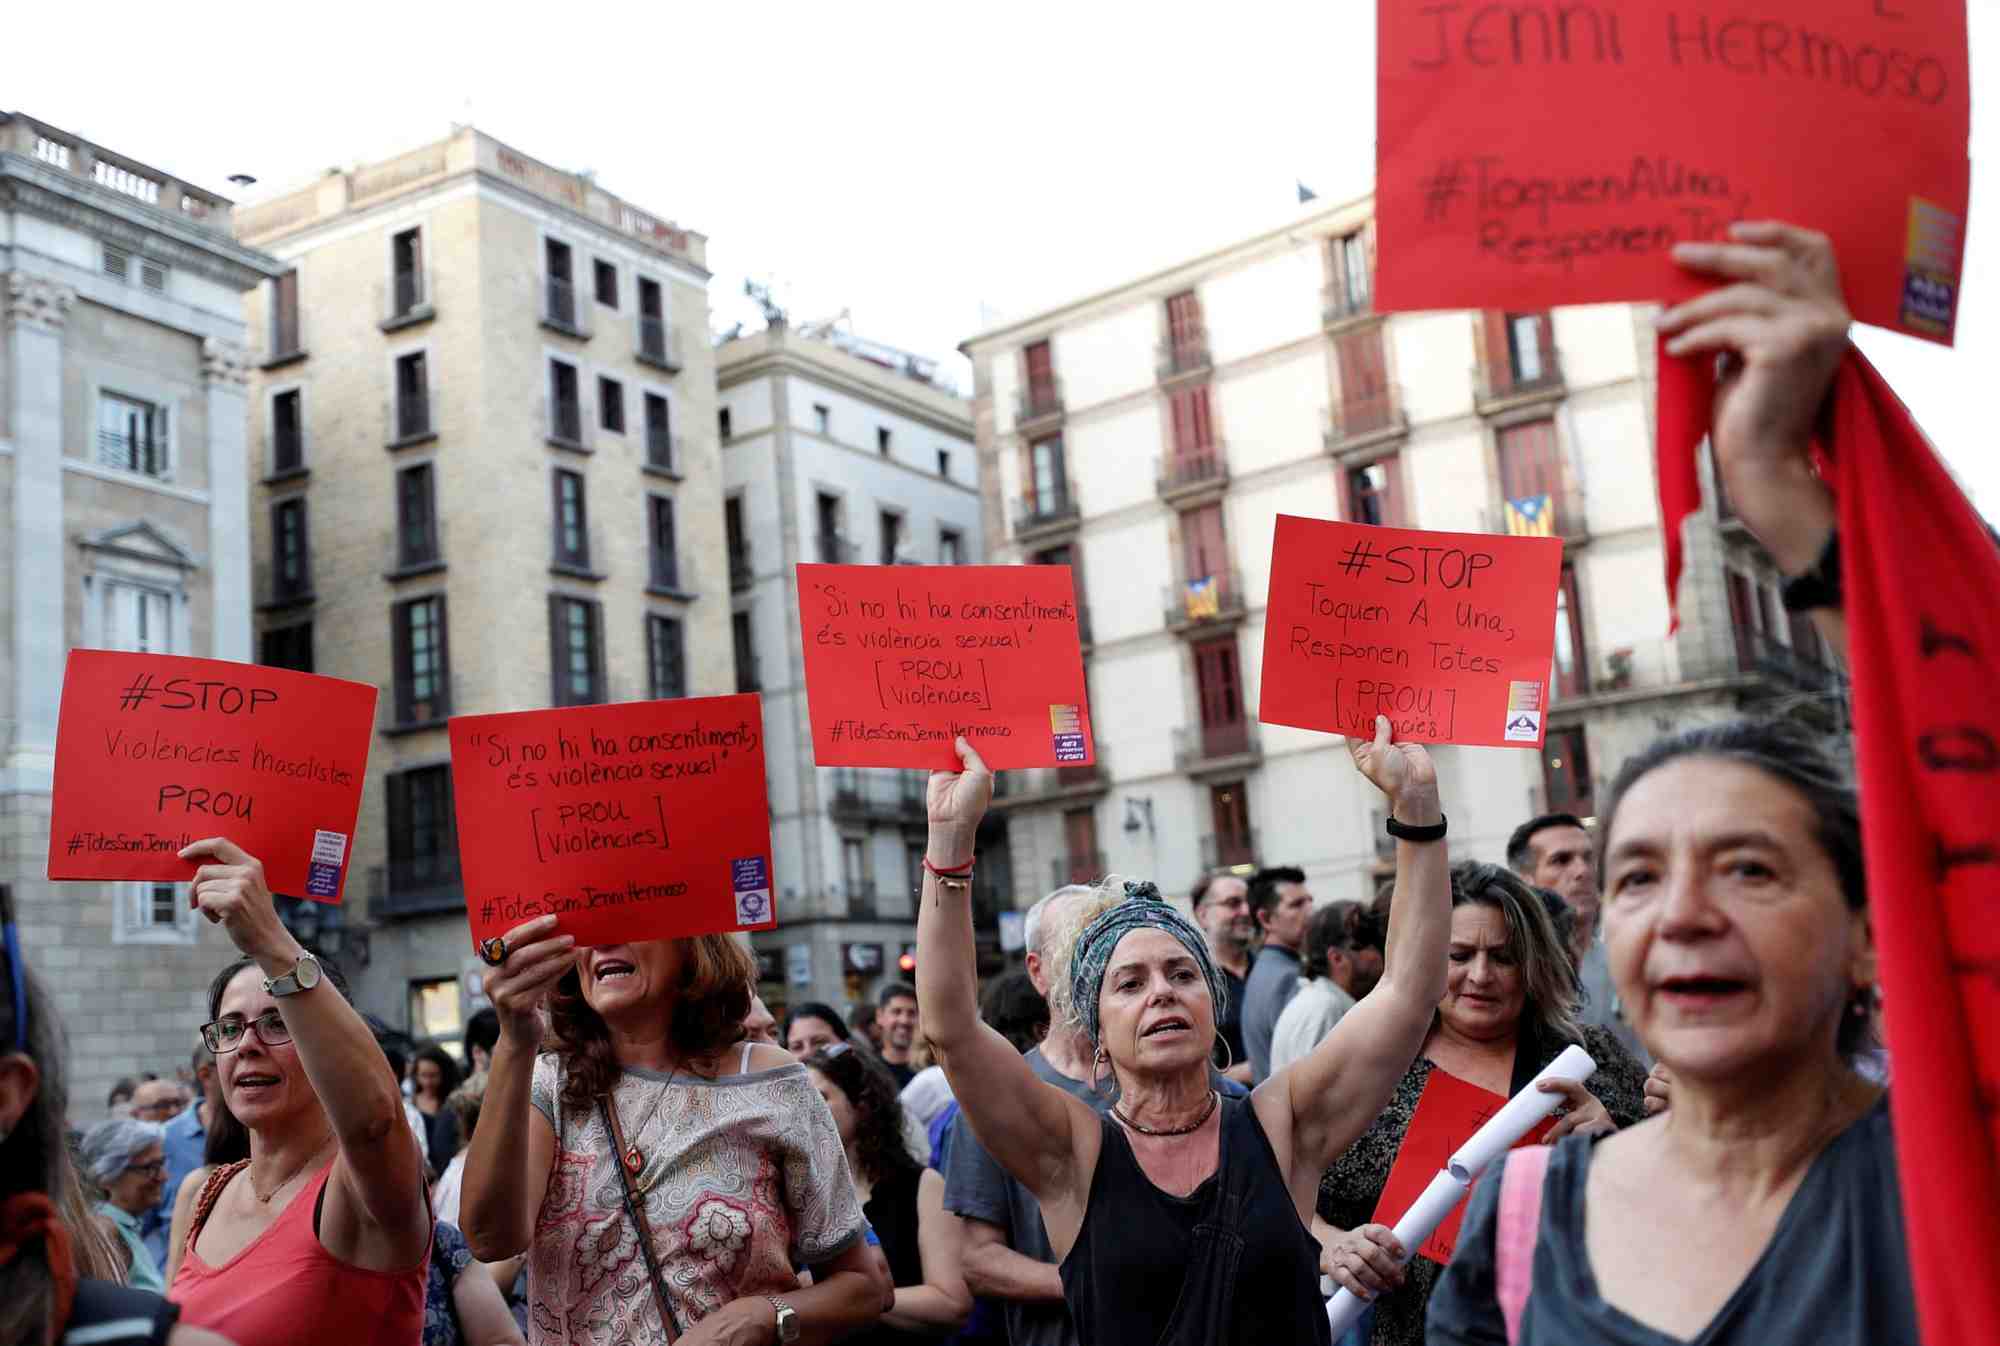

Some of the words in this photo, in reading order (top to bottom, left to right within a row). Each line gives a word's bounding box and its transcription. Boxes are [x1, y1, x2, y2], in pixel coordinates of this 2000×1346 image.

[1337, 540, 1493, 589] #STOP
[860, 599, 886, 619] no
[896, 587, 917, 620] hi
[927, 591, 952, 619] ha
[959, 594, 1075, 622] consentiment,
[1306, 582, 1391, 636] Toquen
[1408, 598, 1429, 627] A
[1455, 603, 1516, 641] Una,
[816, 623, 848, 646] és
[857, 626, 943, 649] violència
[1290, 625, 1409, 669] Responen
[1429, 642, 1502, 674] Totes
[900, 658, 963, 681] PROU
[120, 673, 279, 715] #STOP
[1356, 679, 1434, 717] PROU
[1347, 711, 1438, 738] Vioncies
[521, 743, 547, 761] no
[558, 728, 580, 761] hi
[590, 728, 618, 756] ha
[506, 763, 539, 789] és
[547, 759, 643, 788] violència
[157, 784, 254, 825] PROU
[557, 798, 631, 826] PROU
